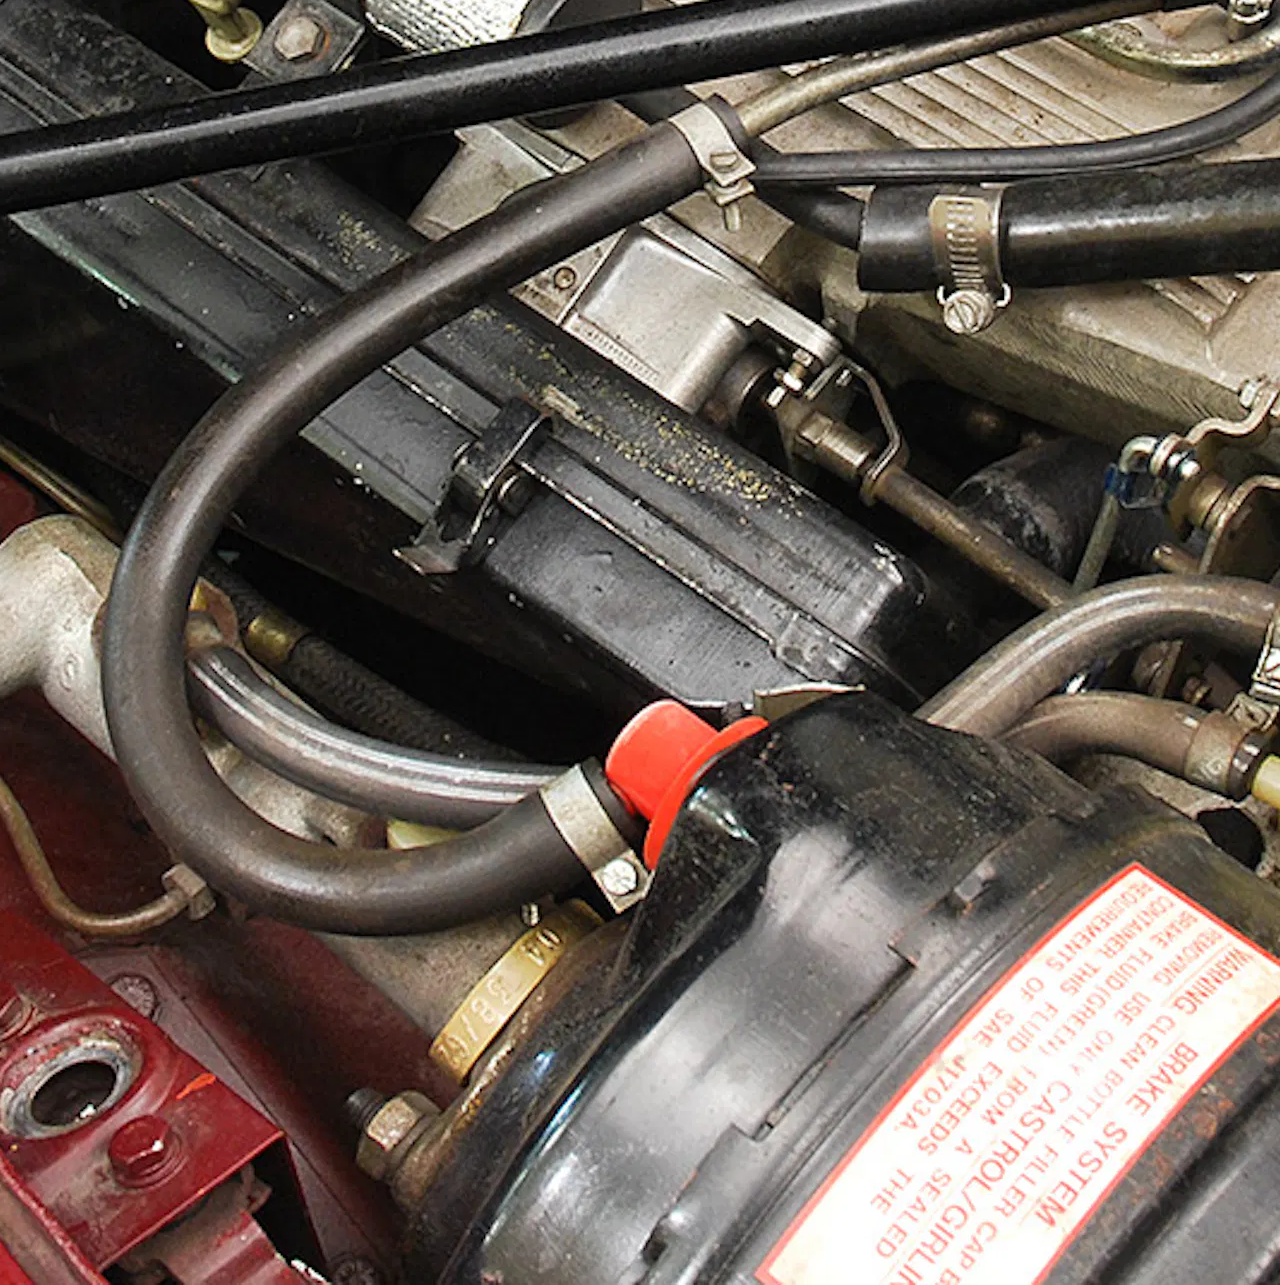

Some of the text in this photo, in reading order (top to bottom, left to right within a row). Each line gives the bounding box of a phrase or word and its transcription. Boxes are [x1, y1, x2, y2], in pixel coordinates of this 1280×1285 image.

[1149, 909, 1198, 949] BRAKE
[1152, 925, 1224, 988] REMOVING
[893, 879, 1154, 1135] REQUIREMENTS OF SAE J1703A.
[1058, 959, 1100, 997] THIS
[1171, 945, 1254, 1017] WARNING
[1005, 1000, 1059, 1055] FLUID
[1113, 990, 1151, 1027] USE
[1118, 1013, 1176, 1070] CLEAN
[916, 1060, 1003, 1157] EXCEEDS
[1057, 1068, 1124, 1141] BOTTLE
[954, 1137, 976, 1157] A
[1032, 1041, 1200, 1229] BRAKE SYSTEM
[869, 1167, 912, 1214] THE
[992, 1143, 1060, 1219] FILLER
[874, 1169, 952, 1260] SEALED
[956, 1219, 999, 1271] CAP
